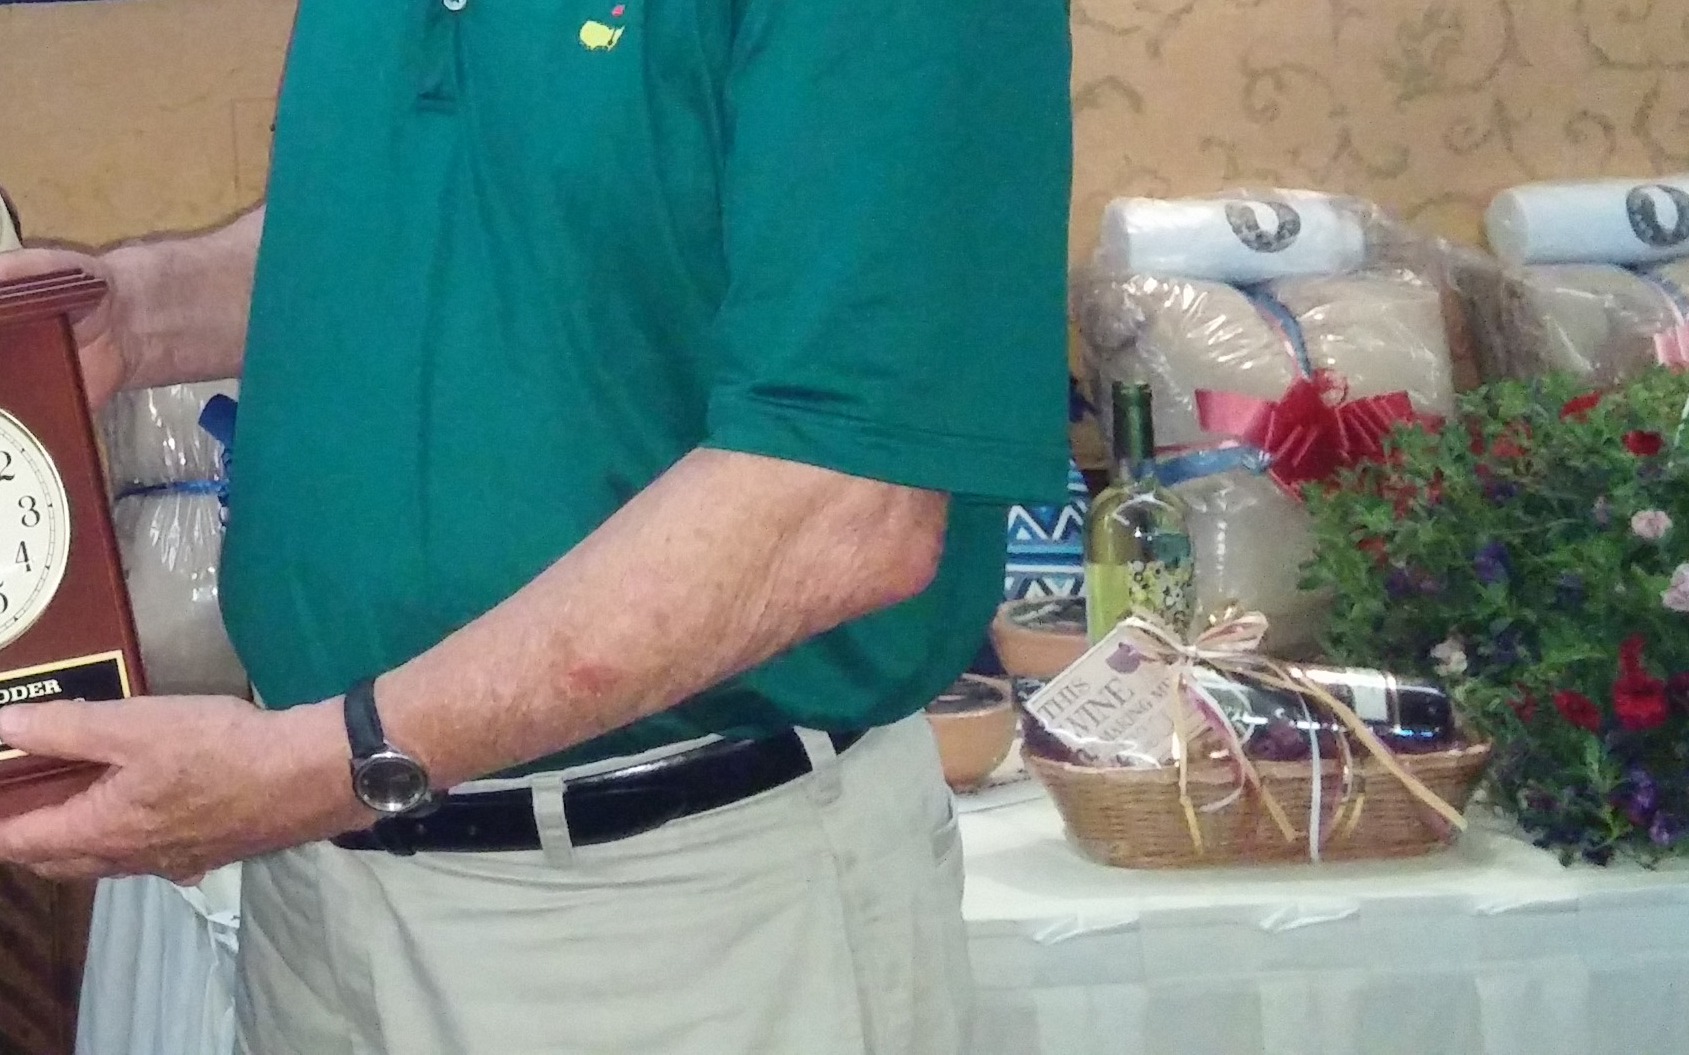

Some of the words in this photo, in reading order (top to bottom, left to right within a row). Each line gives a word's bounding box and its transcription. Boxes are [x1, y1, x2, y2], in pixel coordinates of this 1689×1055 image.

[18, 495, 41, 527] 3
[15, 540, 32, 572] 4
[1037, 677, 1090, 720] THIS
